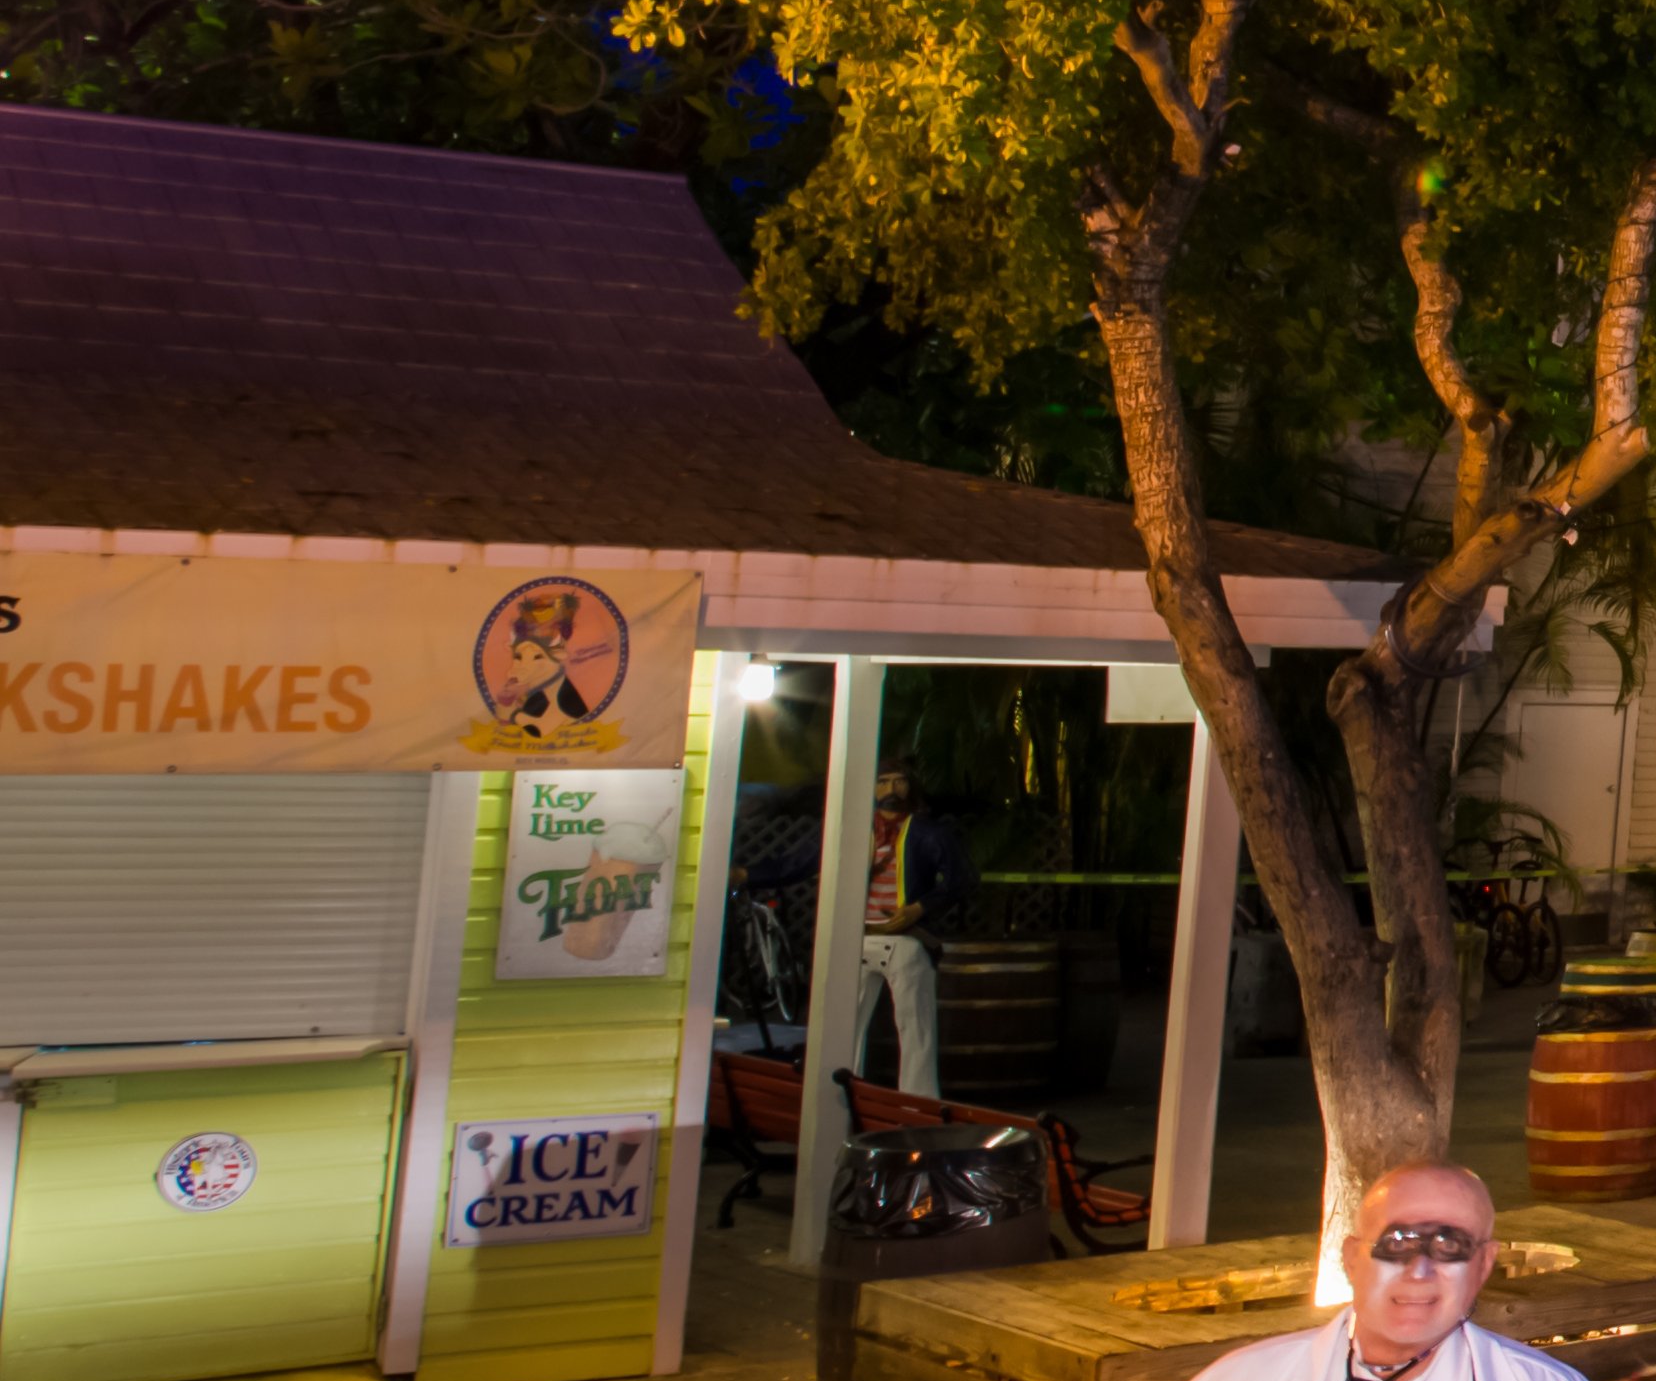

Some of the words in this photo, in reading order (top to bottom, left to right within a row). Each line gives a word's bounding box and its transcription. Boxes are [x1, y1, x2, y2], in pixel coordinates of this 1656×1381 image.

[0, 661, 372, 735] KSHAKES
[531, 783, 597, 814] Key
[529, 812, 606, 840] Lime
[518, 869, 661, 943] FLOAT
[503, 1128, 611, 1186] ICE
[465, 1185, 640, 1230] CREAM
